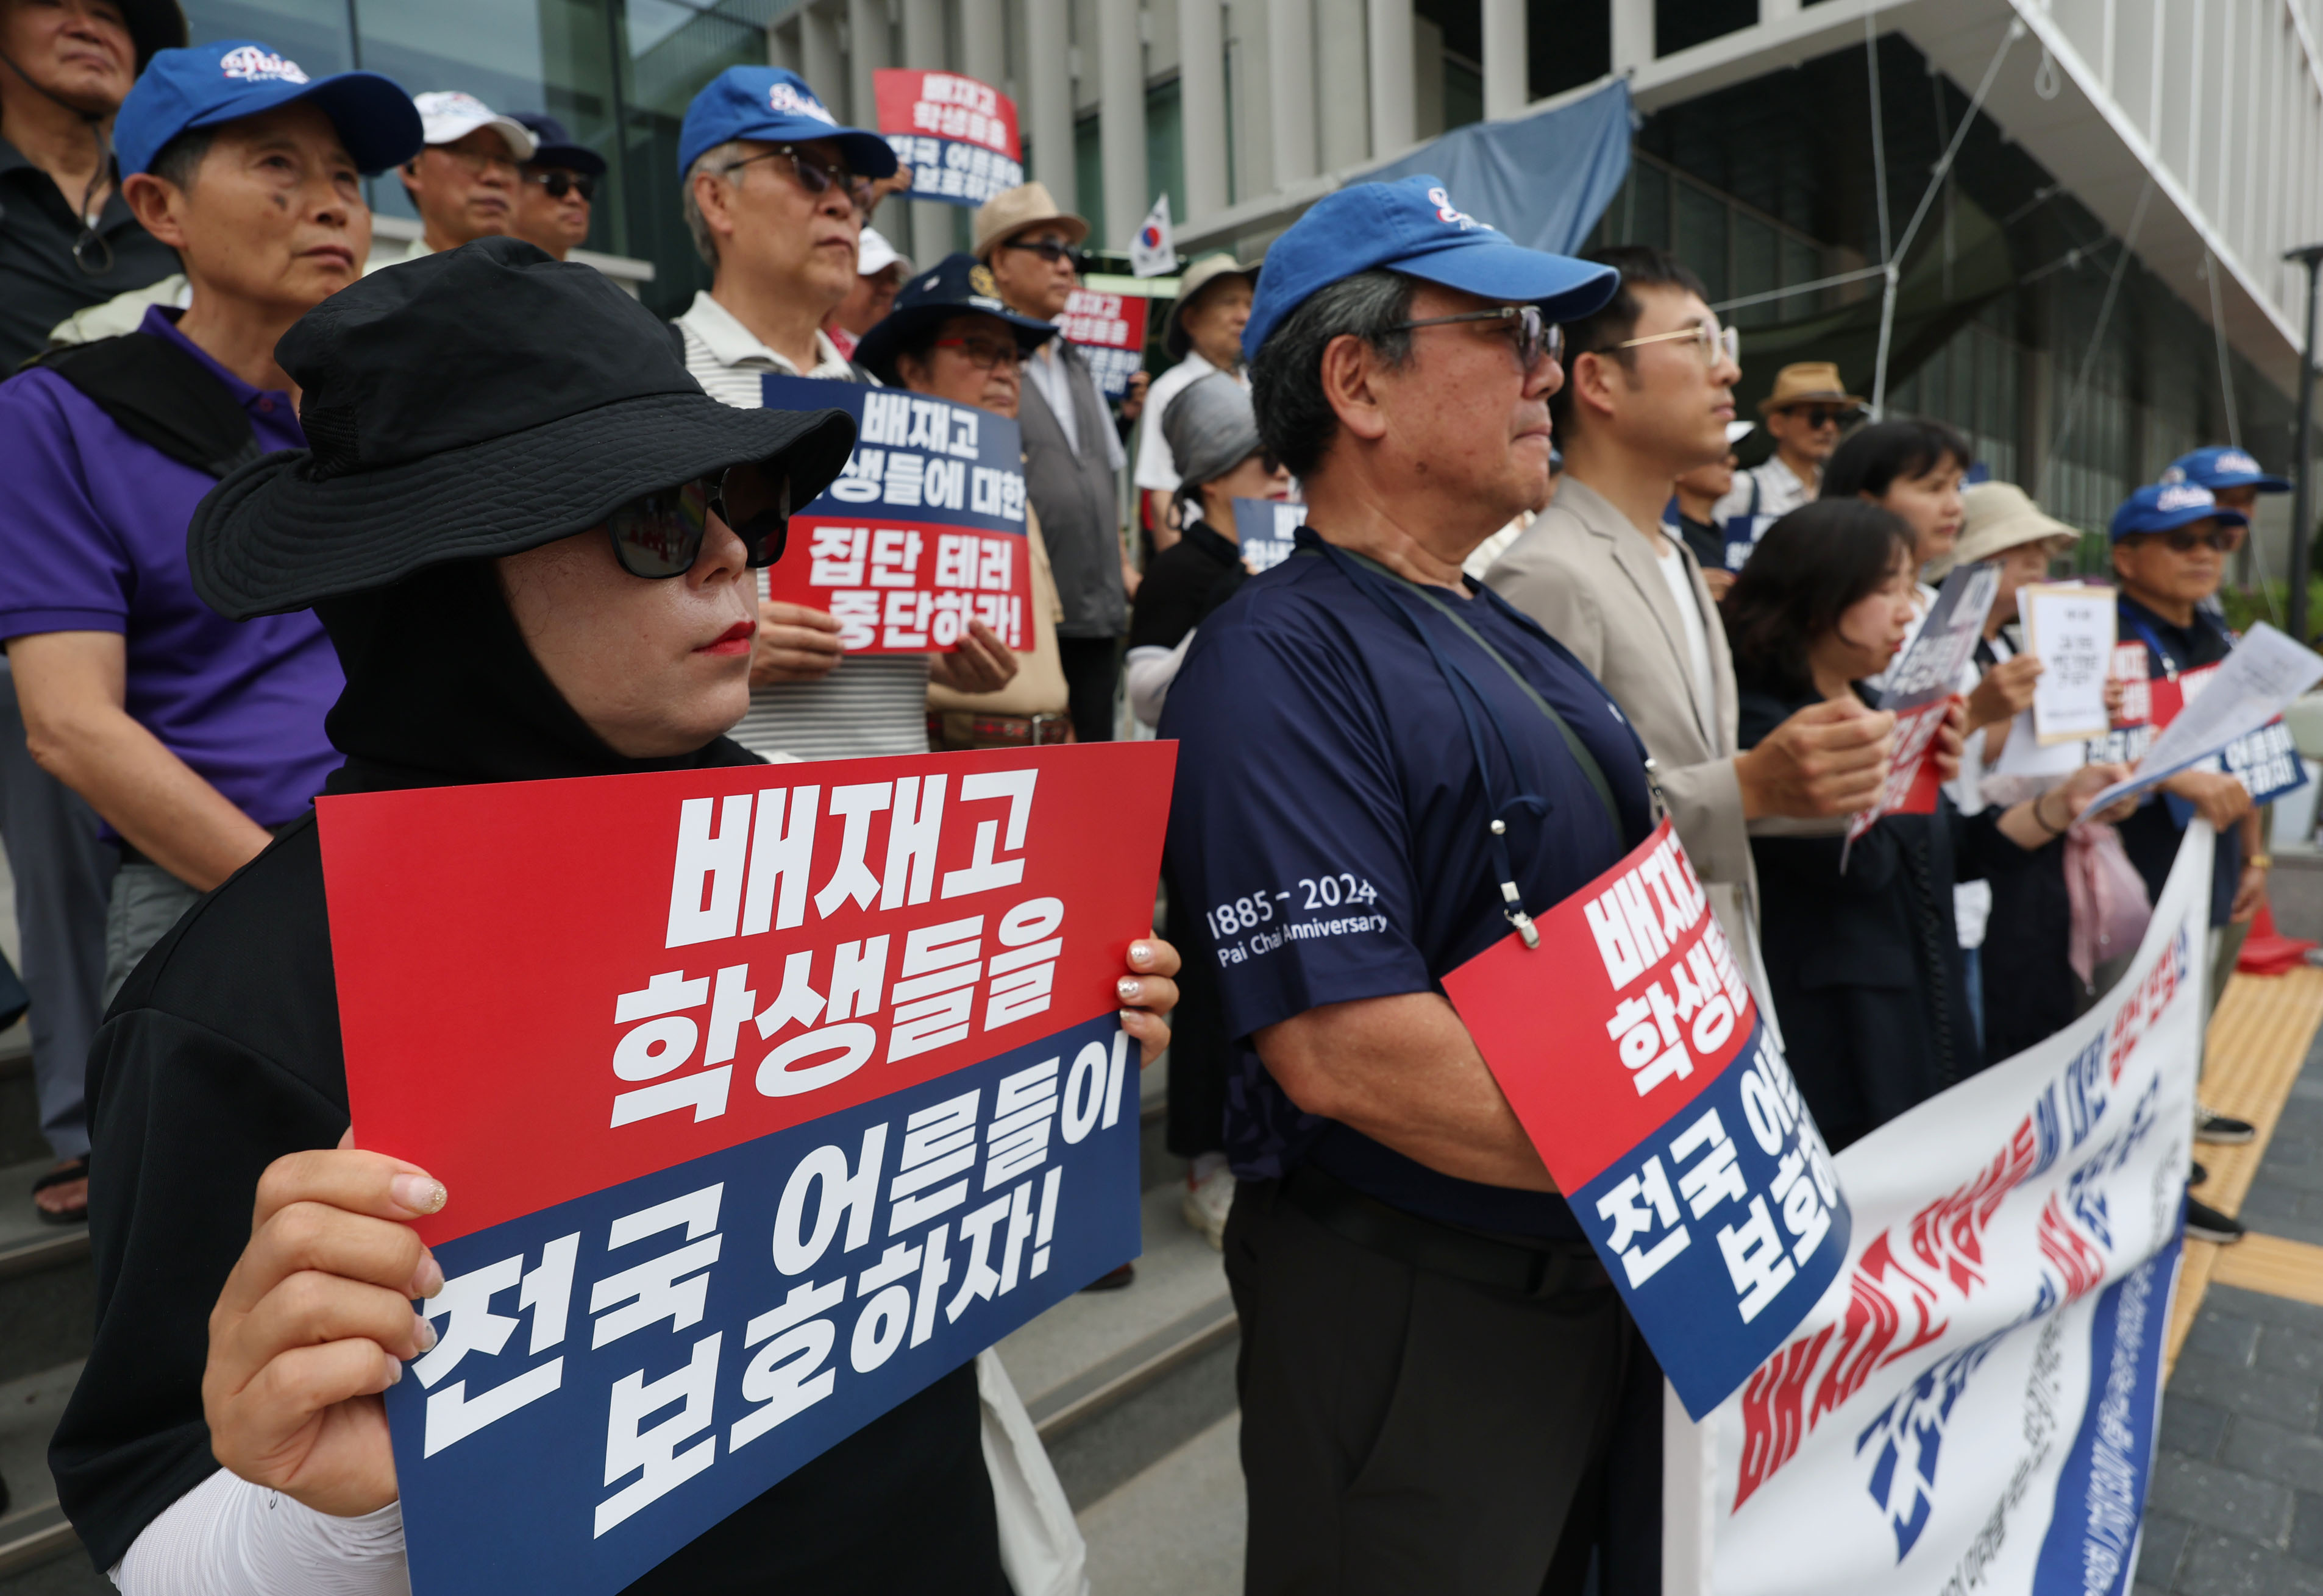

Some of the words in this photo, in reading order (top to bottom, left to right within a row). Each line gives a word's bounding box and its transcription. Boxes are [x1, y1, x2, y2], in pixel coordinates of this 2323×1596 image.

[817, 448, 966, 511] 생들에
[970, 464, 1027, 522] 대한
[860, 391, 979, 459] 배재고
[808, 526, 923, 587] 집단
[934, 533, 1012, 592] 테러
[665, 768, 1039, 949] 배재고
[1217, 940, 1248, 968] Pai
[1282, 914, 1387, 943] Anniversary
[610, 896, 1064, 1129] 학생들을
[412, 1181, 725, 1459] 전국
[772, 1029, 1129, 1277] 어른들이
[1595, 1107, 1748, 1290] 전국
[593, 1165, 1062, 1541] 보호하자!
